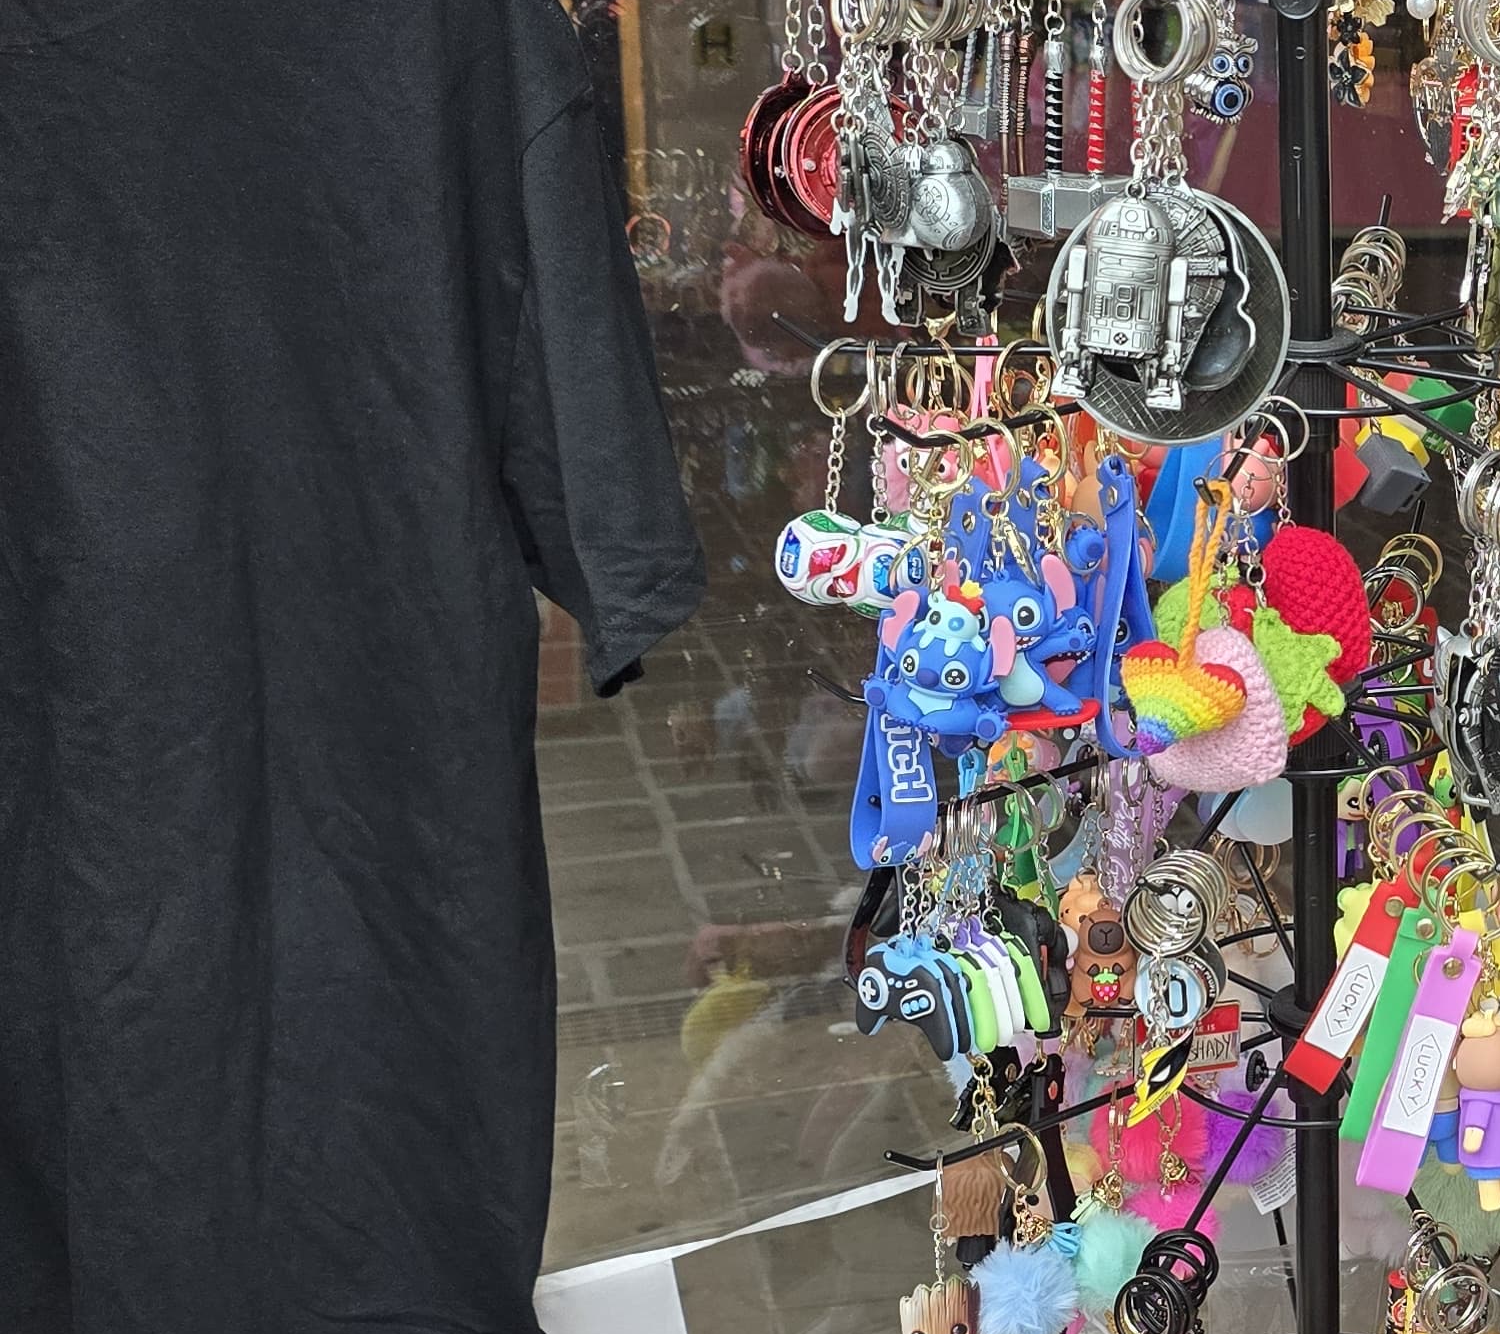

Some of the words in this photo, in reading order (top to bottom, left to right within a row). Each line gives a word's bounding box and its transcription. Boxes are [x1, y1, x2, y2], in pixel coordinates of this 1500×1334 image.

[1332, 971, 1369, 1029] LUCKY
[1188, 1032, 1232, 1063] SHADY
[1407, 1043, 1434, 1106] LUCKY
